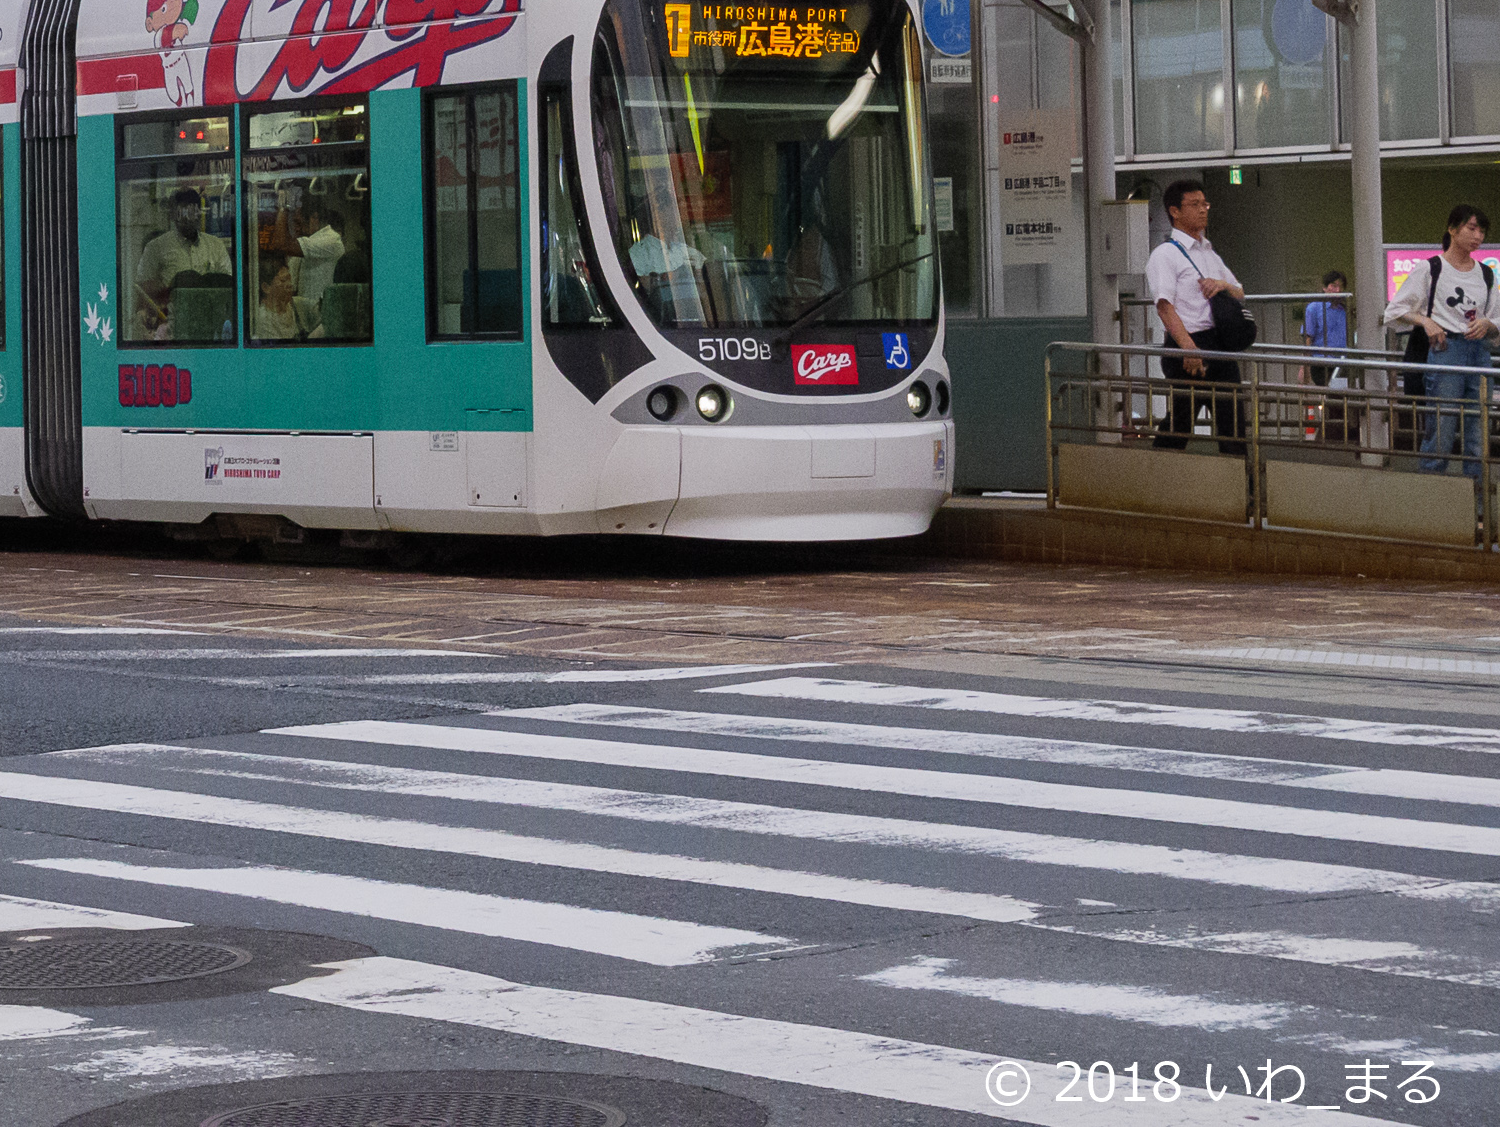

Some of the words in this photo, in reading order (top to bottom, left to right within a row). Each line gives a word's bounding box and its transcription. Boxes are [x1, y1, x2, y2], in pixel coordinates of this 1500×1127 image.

[703, 5, 798, 22] HIROSHIMA
[807, 8, 848, 22] PORT
[736, 21, 824, 58] 広島港
[797, 349, 852, 380] Carp
[224, 469, 252, 478] HIROSHIMA
[253, 469, 266, 478] TOYO
[267, 469, 281, 478] CARP
